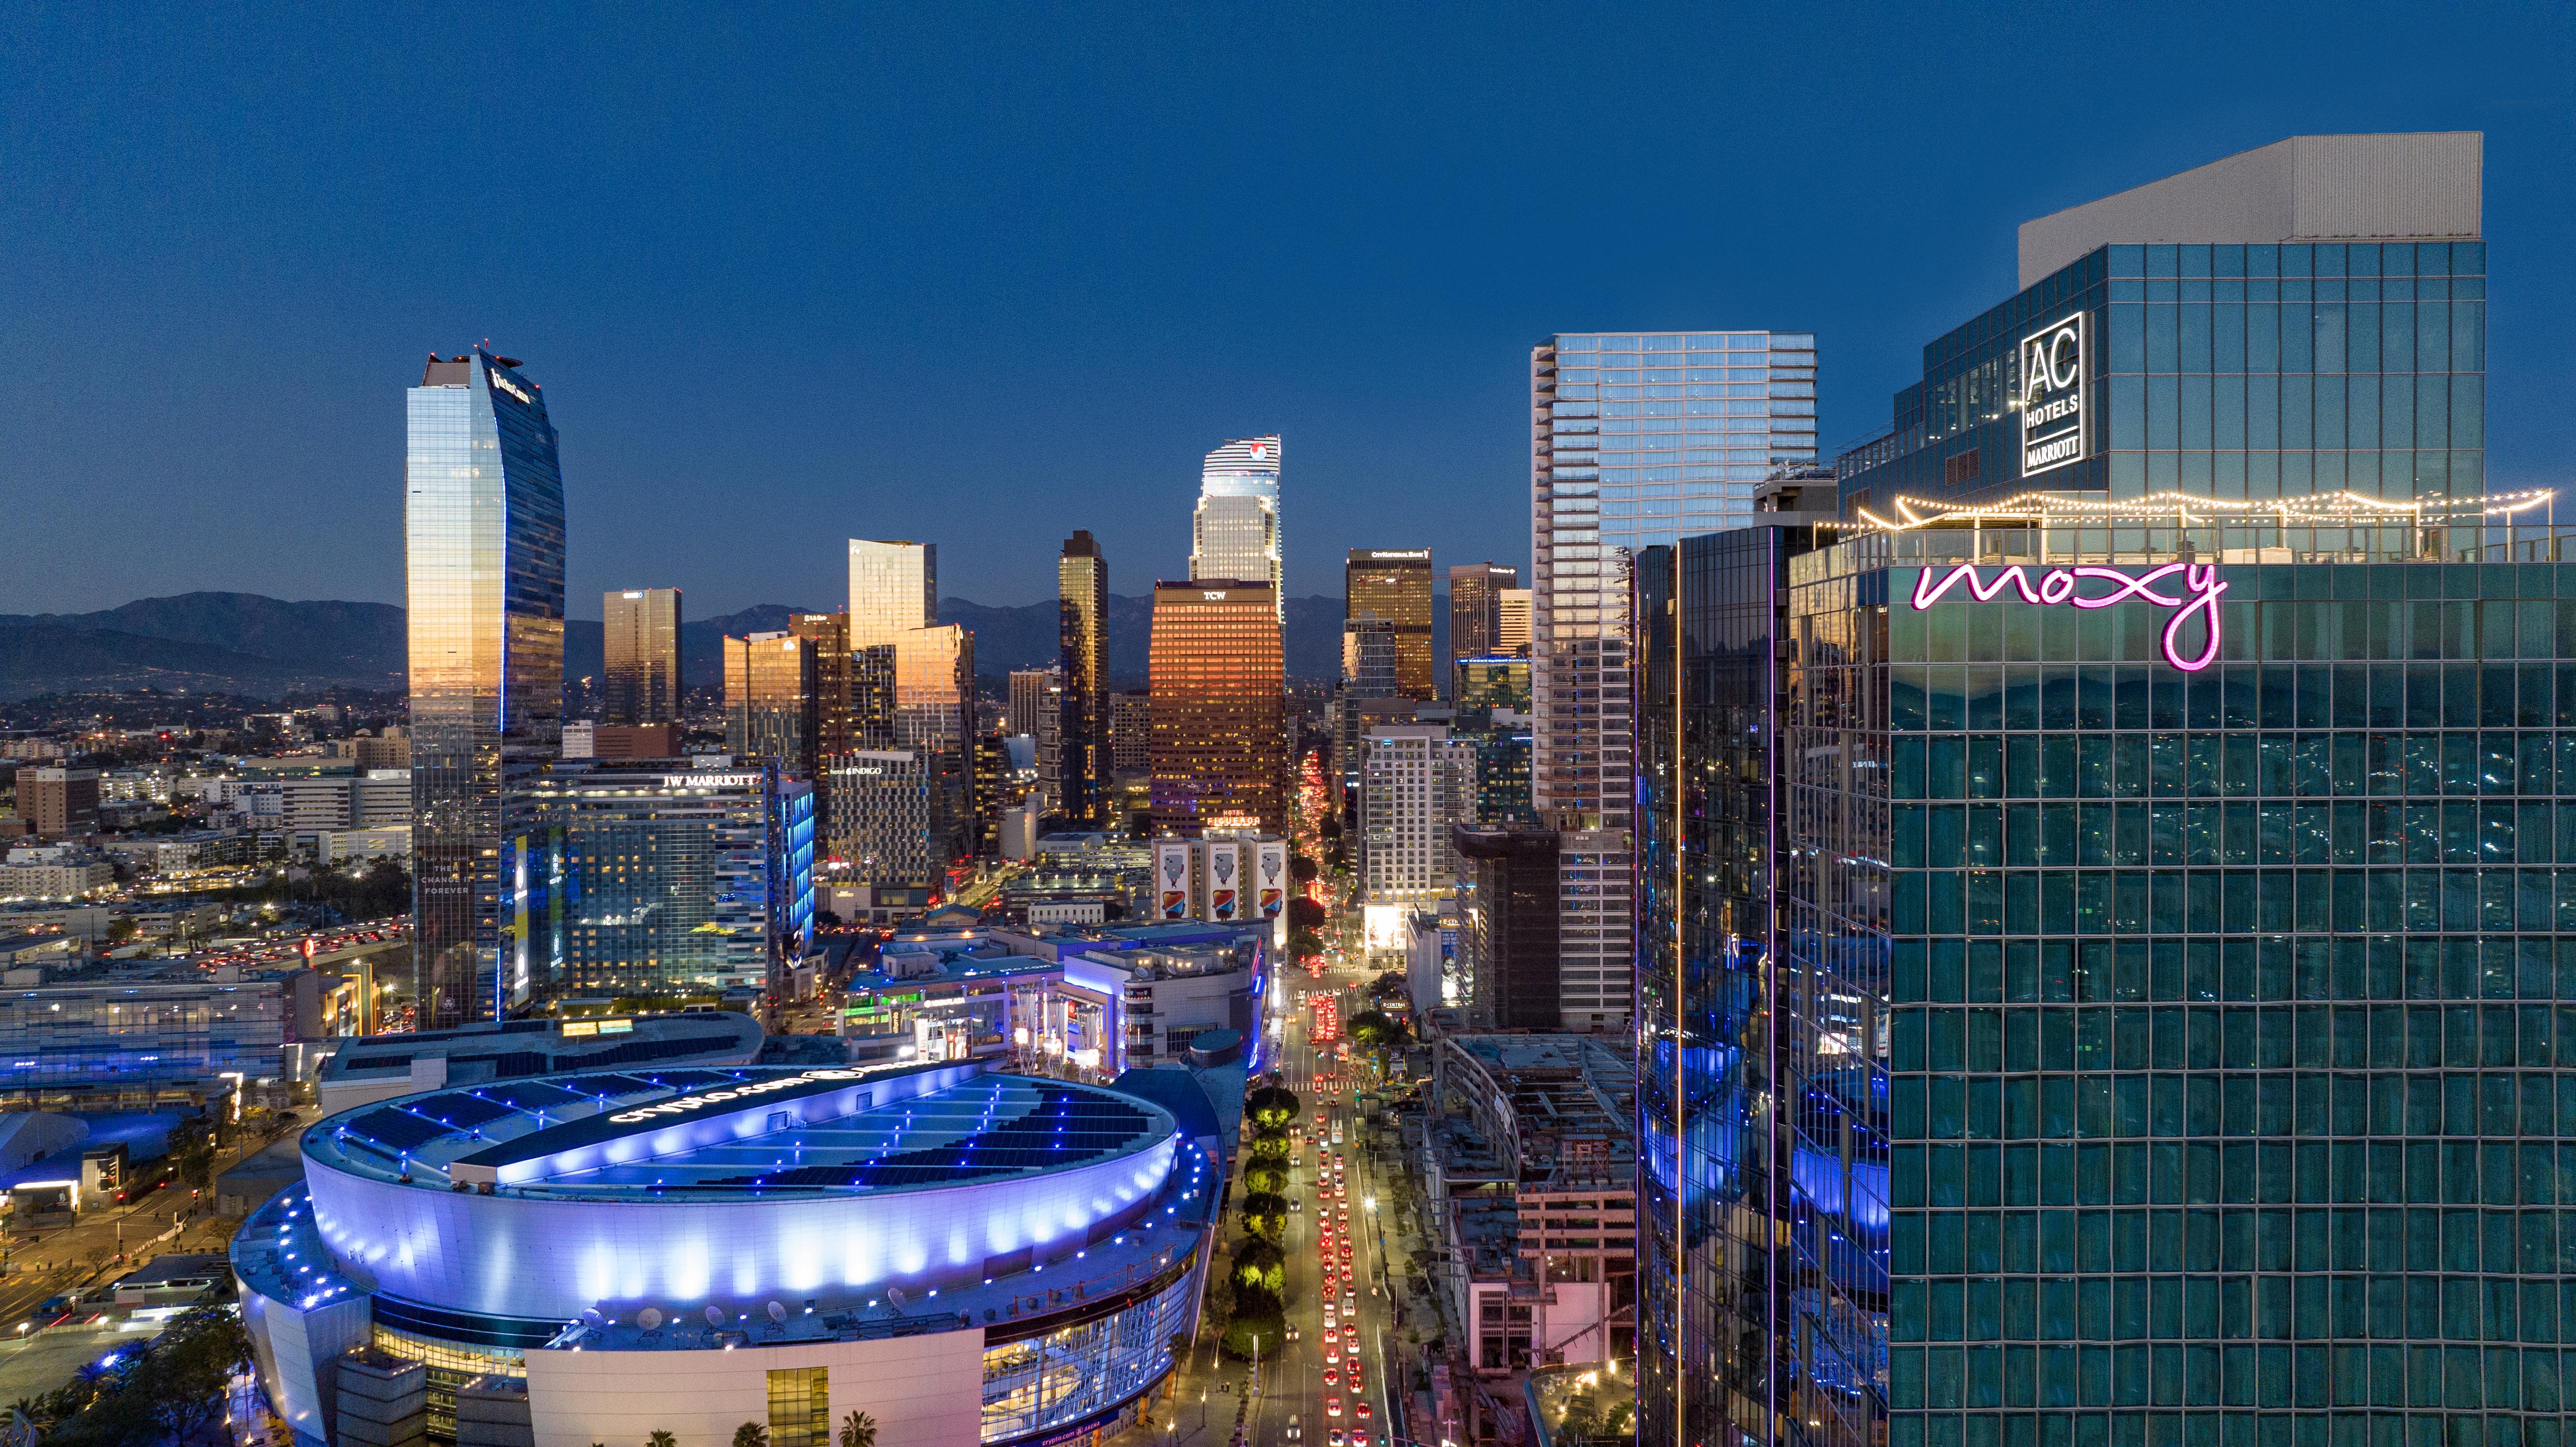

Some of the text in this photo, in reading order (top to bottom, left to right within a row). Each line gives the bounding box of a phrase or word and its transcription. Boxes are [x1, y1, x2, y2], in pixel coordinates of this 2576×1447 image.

[2027, 328, 2077, 401] AC
[2027, 395, 2078, 428] HOTELS
[2027, 436, 2078, 468] MARRIOTT
[1203, 592, 1226, 600] TCW
[1912, 563, 2228, 671] moxy
[663, 775, 756, 787] JW MARRIOTT
[1207, 817, 1261, 826] FIGUEROA
[609, 1076, 815, 1123] crypto.com
[1042, 1421, 1100, 1446] crypto.com ARENA
